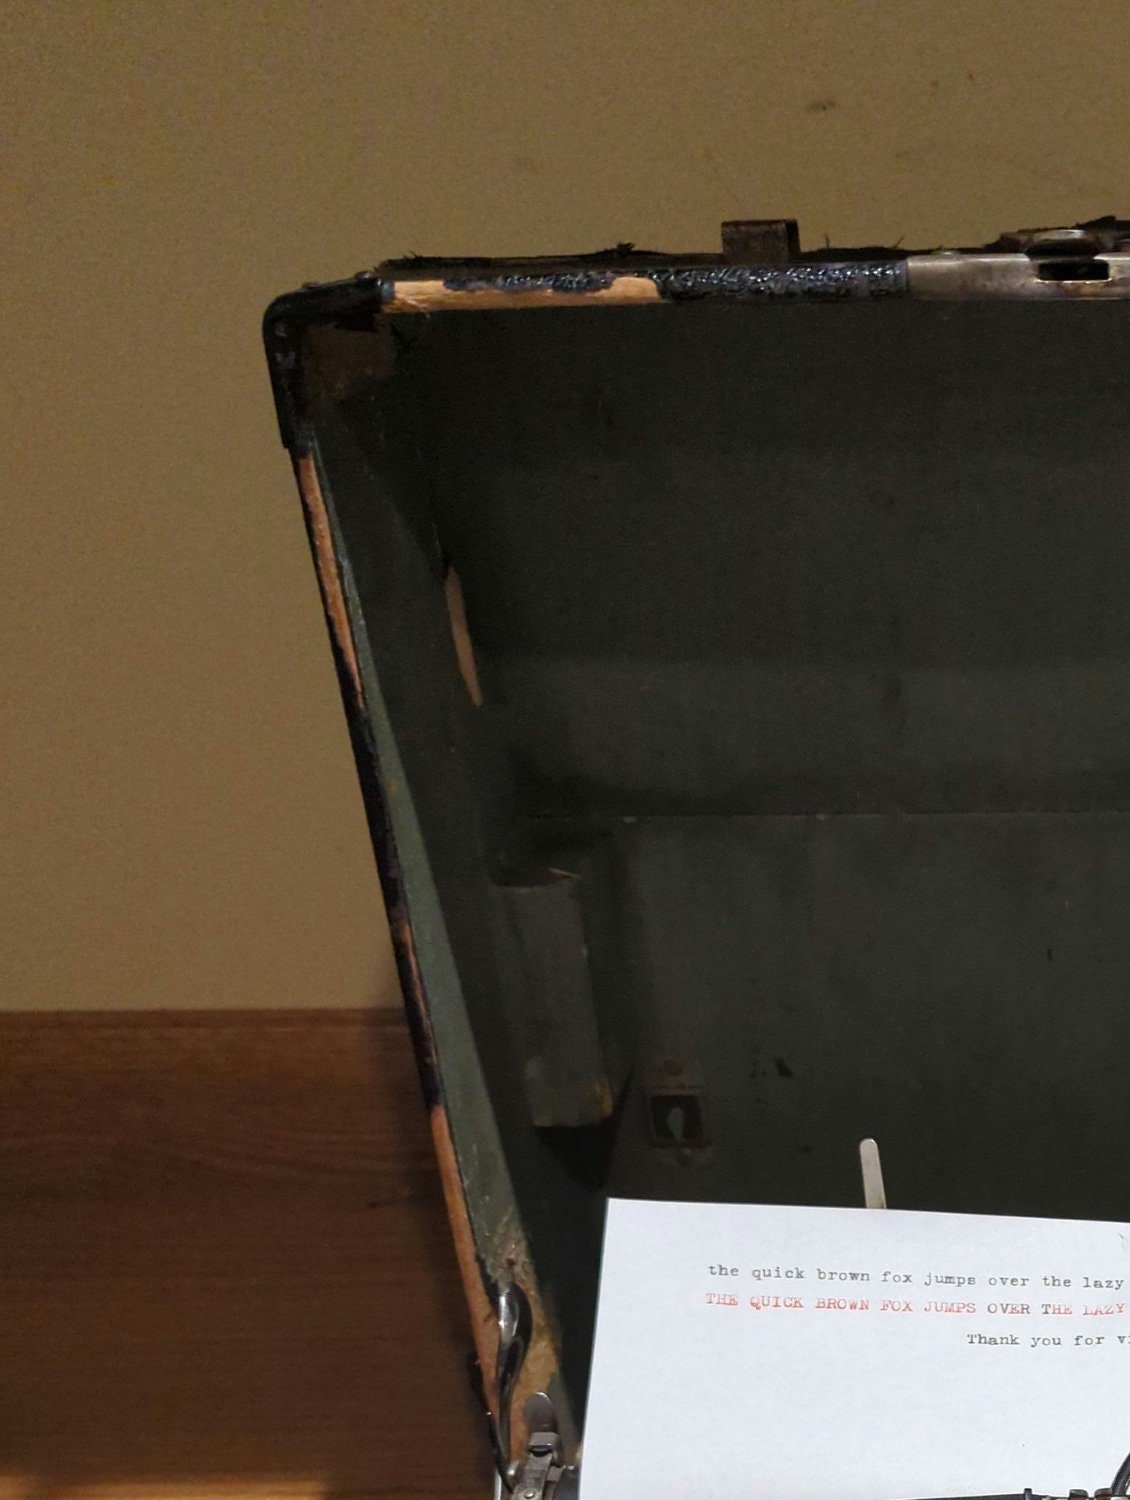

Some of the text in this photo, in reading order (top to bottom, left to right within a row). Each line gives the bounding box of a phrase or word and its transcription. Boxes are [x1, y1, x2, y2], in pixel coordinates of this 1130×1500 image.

[708, 1264, 740, 1277] the
[751, 1266, 807, 1281] quick
[816, 1268, 871, 1283] brown
[880, 1271, 914, 1284] fox
[924, 1272, 977, 1288] jumps
[988, 1275, 1031, 1287] over
[1042, 1276, 1072, 1288] the
[1082, 1276, 1125, 1291] lazy
[706, 1293, 738, 1306] THE
[749, 1295, 804, 1310] QUICK
[815, 1297, 870, 1311] BROWN
[880, 1300, 914, 1313] FOX
[924, 1301, 977, 1314] JUMPS
[987, 1302, 1031, 1315] OVER
[1042, 1304, 1073, 1315] THE
[1082, 1303, 1125, 1316] LAZY
[967, 1333, 1019, 1346] Thank
[1030, 1335, 1062, 1349] you
[1073, 1334, 1105, 1347] for
